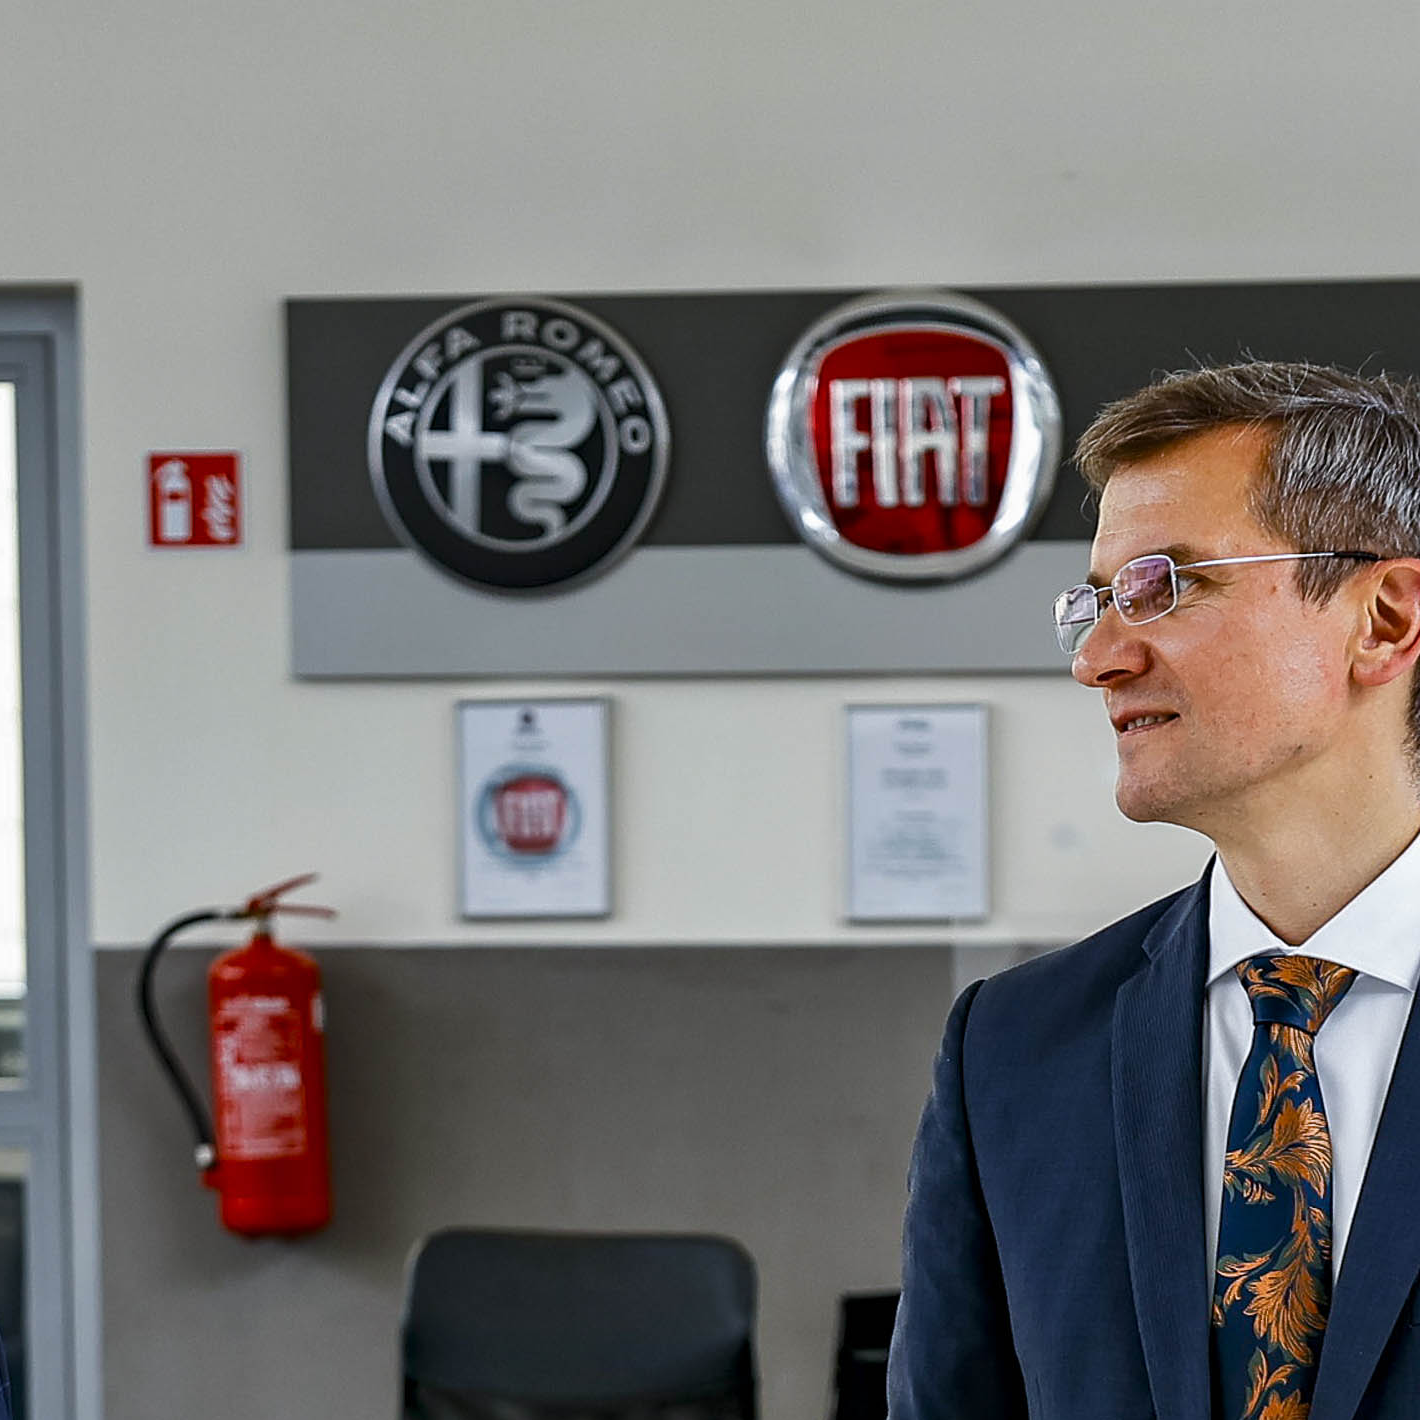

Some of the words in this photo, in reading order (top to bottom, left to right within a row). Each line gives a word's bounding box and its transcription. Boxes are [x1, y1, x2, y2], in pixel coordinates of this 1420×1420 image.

[385, 327, 479, 446] ALFA
[500, 310, 651, 454] ROMEO
[829, 376, 1006, 507] FIAT
